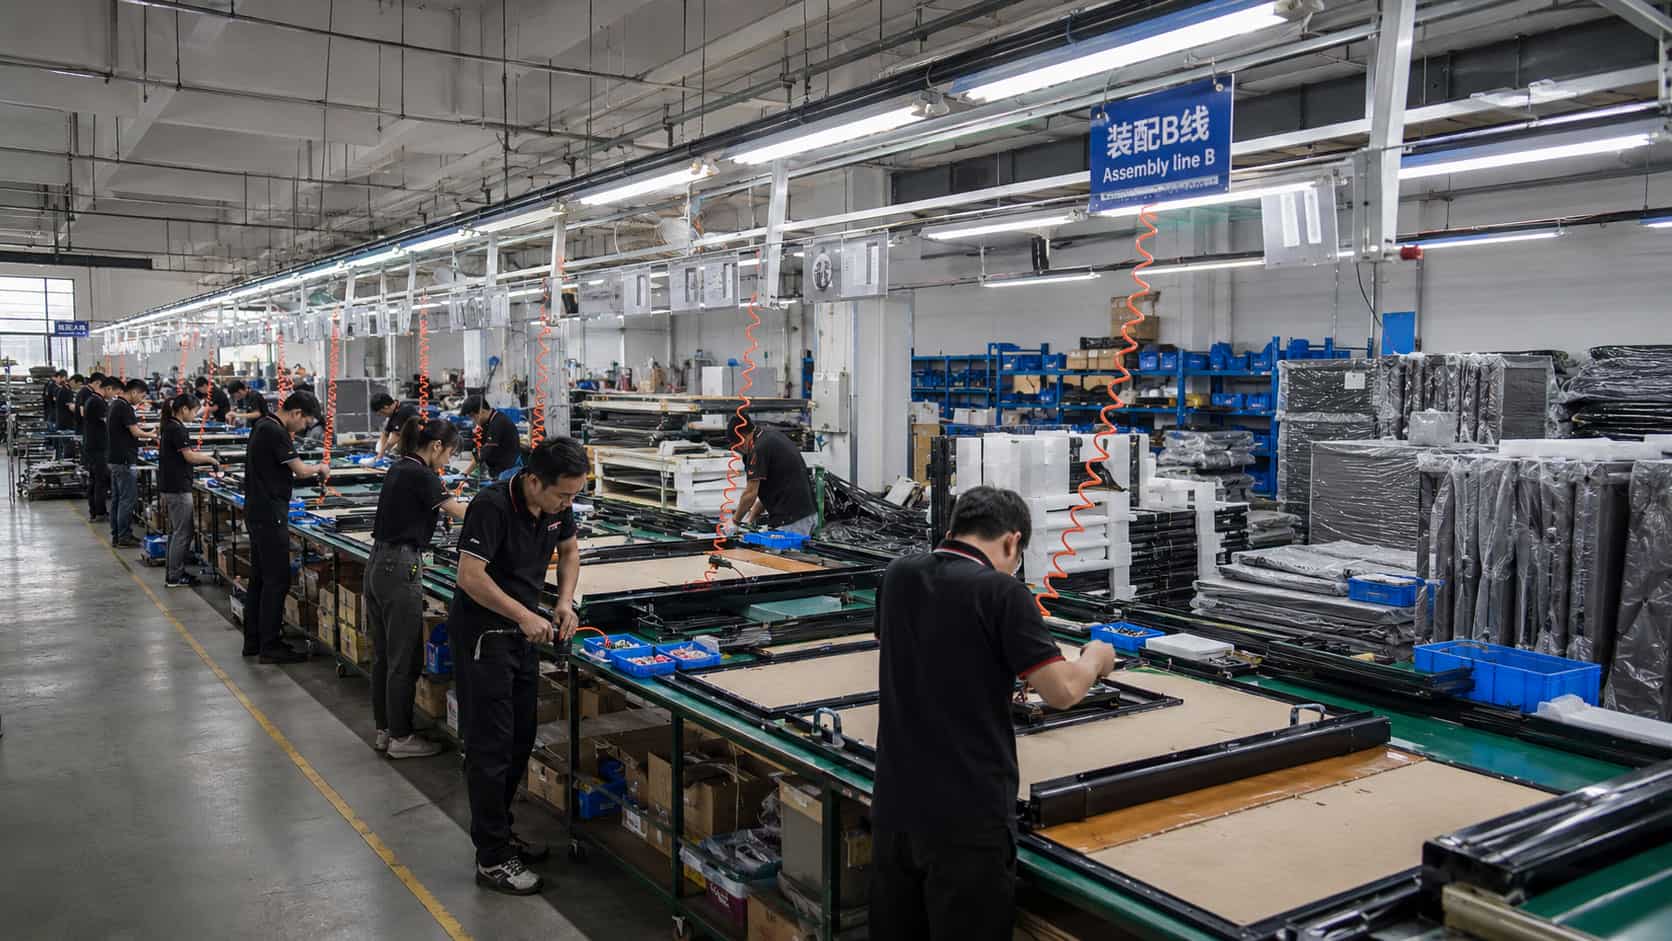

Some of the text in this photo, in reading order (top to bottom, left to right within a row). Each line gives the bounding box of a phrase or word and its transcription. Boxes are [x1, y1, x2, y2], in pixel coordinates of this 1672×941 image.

[1106, 105, 1209, 159] 装配B线
[1103, 148, 1215, 183] Assembly line B
